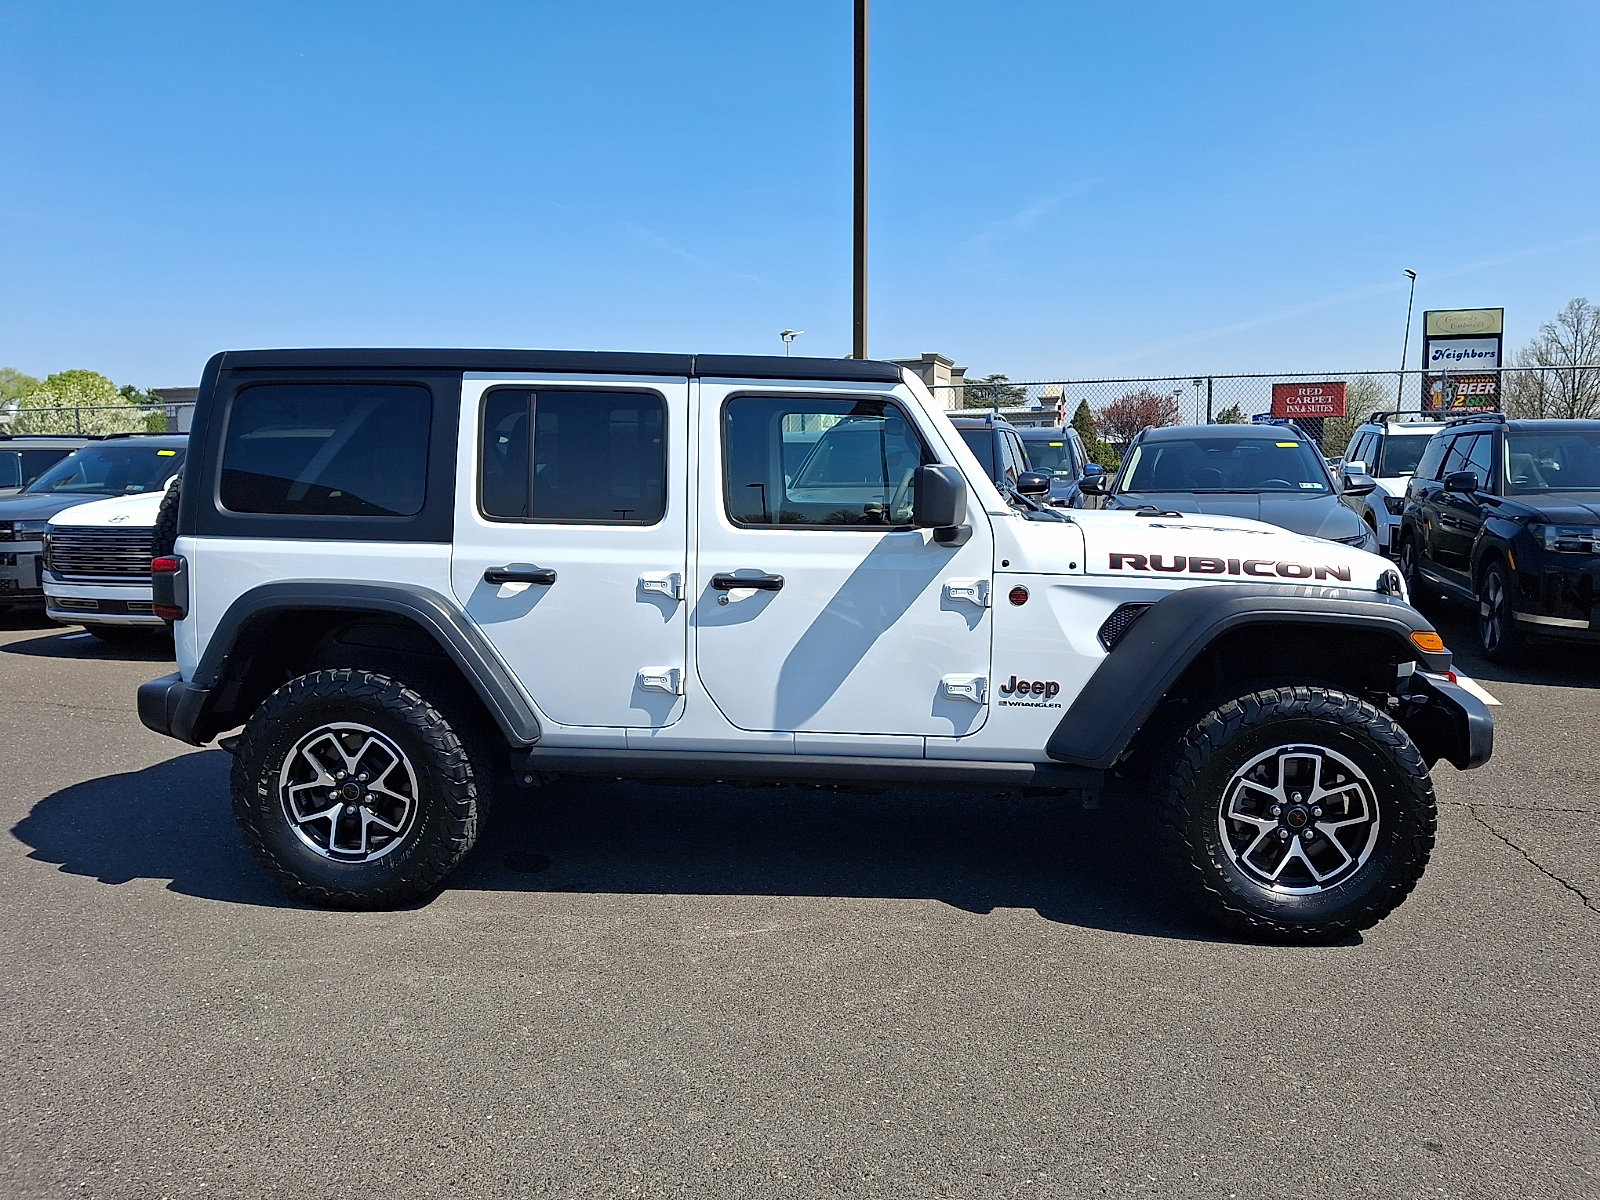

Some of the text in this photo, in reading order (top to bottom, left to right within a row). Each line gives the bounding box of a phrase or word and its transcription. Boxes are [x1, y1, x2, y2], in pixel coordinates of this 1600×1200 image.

[1431, 348, 1496, 361] Neighbors
[1298, 387, 1323, 395] RED
[1457, 383, 1496, 395] BEER
[1286, 396, 1334, 404] CARPET
[1453, 395, 1486, 406] 2 GO
[1307, 404, 1333, 412] SUITES
[1109, 553, 1352, 581] RUBICON
[1001, 676, 1060, 698] Jeep
